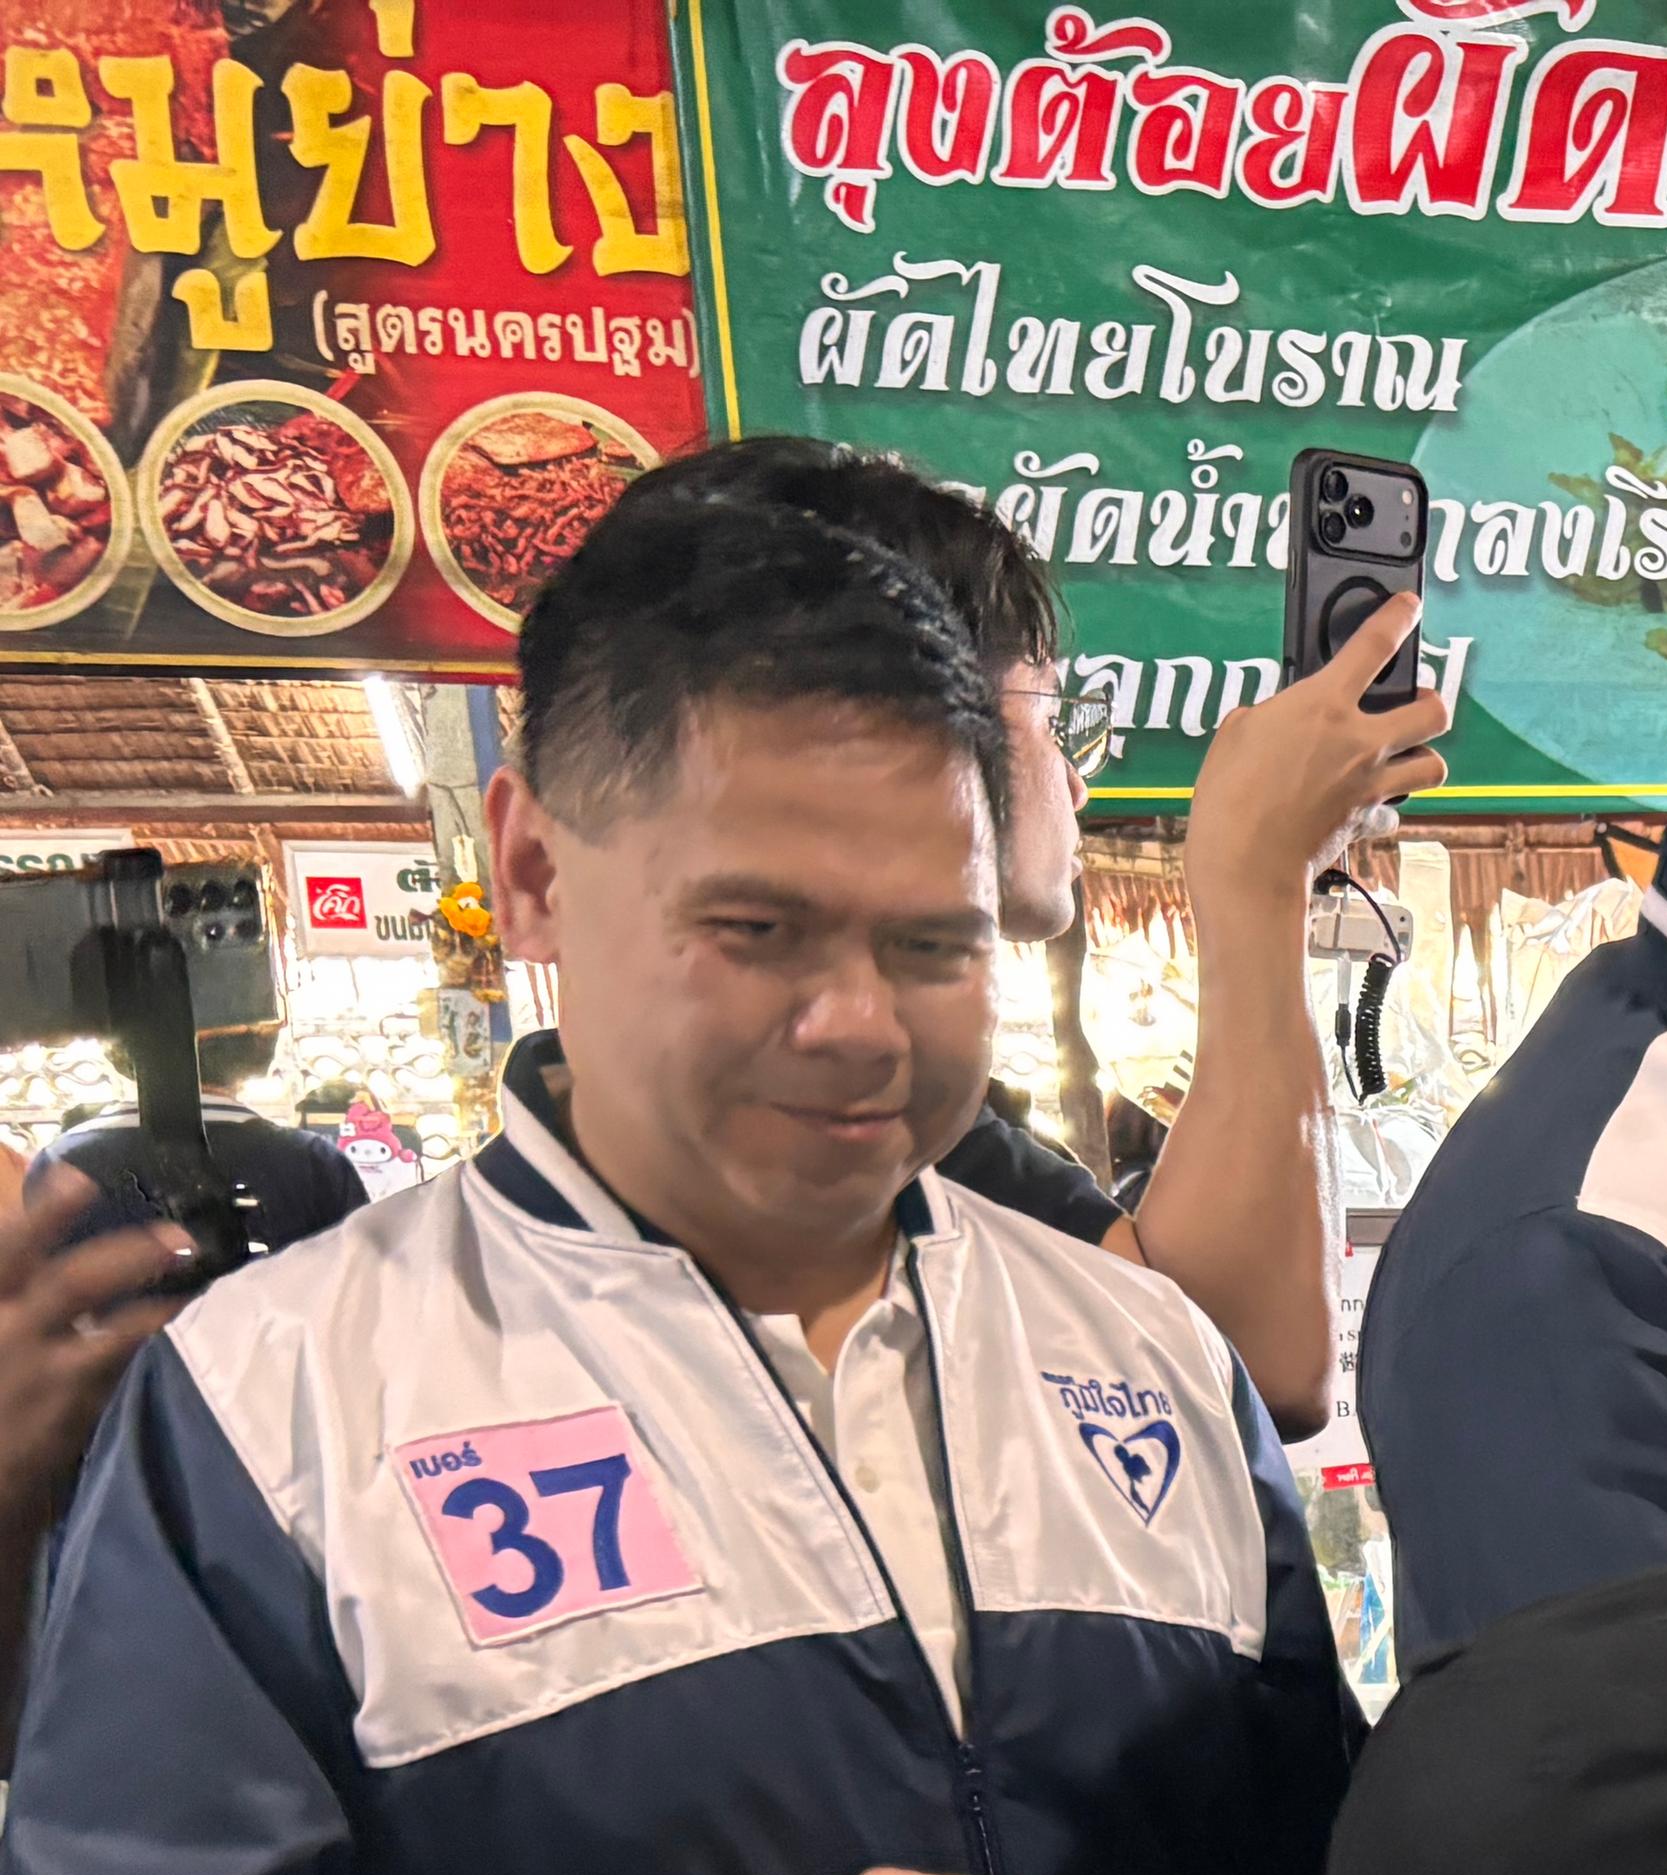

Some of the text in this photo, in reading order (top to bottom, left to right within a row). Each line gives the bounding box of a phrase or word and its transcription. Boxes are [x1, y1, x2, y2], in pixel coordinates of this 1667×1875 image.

[313, 290, 698, 376] (สูตรนครปฐม)
[800, 252, 1468, 412] ผัดไทยโบราณ
[1041, 1371, 1173, 1420] ภูมิใจไทย
[409, 1440, 482, 1479] เบอร์
[441, 1453, 632, 1618] 37
